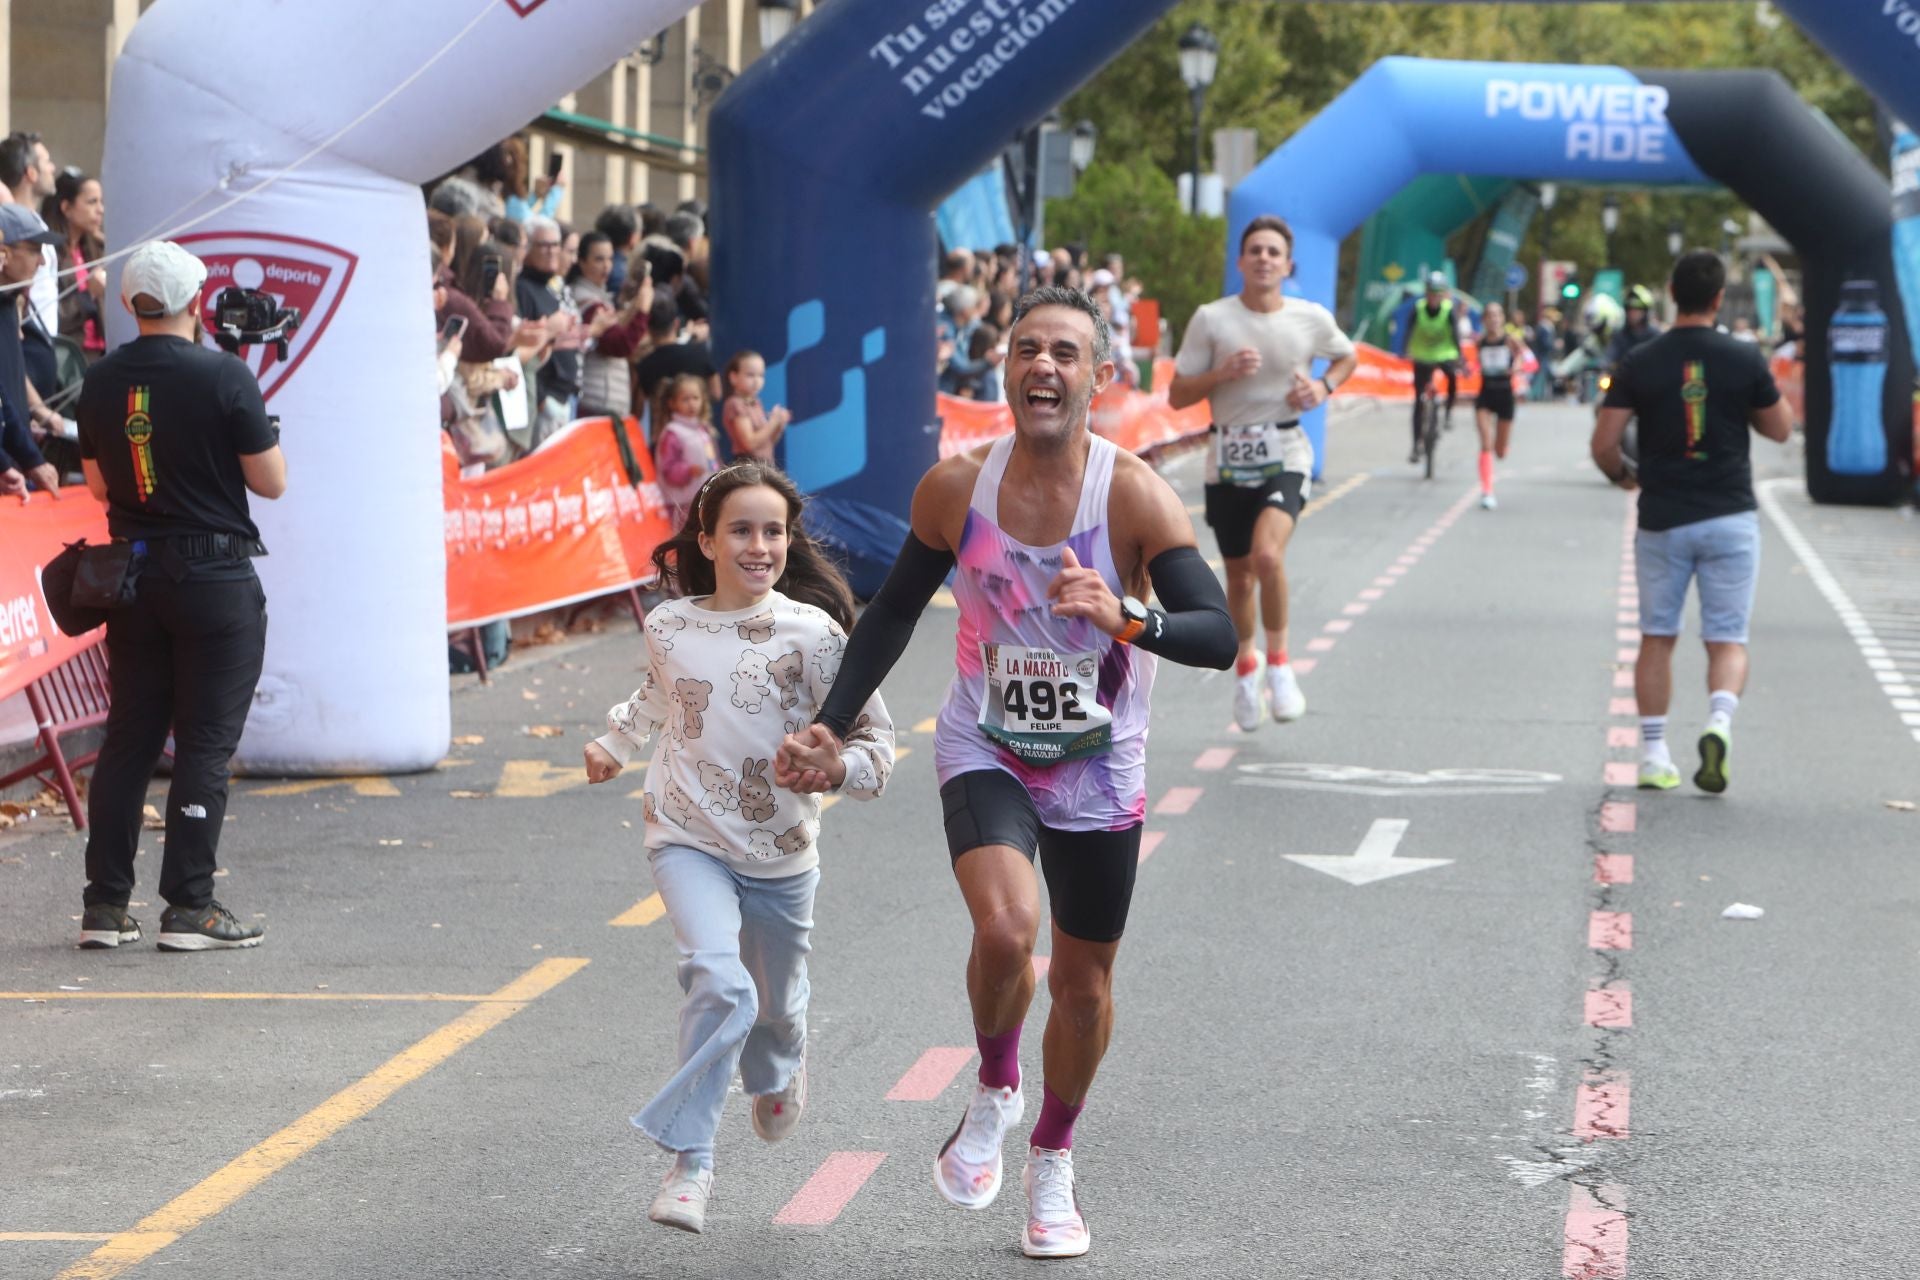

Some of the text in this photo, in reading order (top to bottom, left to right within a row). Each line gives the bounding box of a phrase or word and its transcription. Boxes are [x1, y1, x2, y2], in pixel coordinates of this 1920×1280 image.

[1882, 0, 1920, 49] vo
[869, 24, 927, 69] Tu
[1485, 79, 1669, 124] POWER
[1565, 121, 1667, 163] ADE
[266, 264, 322, 287] deporte
[1229, 441, 1268, 461] 224
[1006, 658, 1020, 675] LA
[1023, 660, 1070, 678] MARAT
[1004, 680, 1088, 720] 492
[1030, 723, 1062, 731] FELIPE
[1009, 740, 1064, 752] CAJA RURAL
